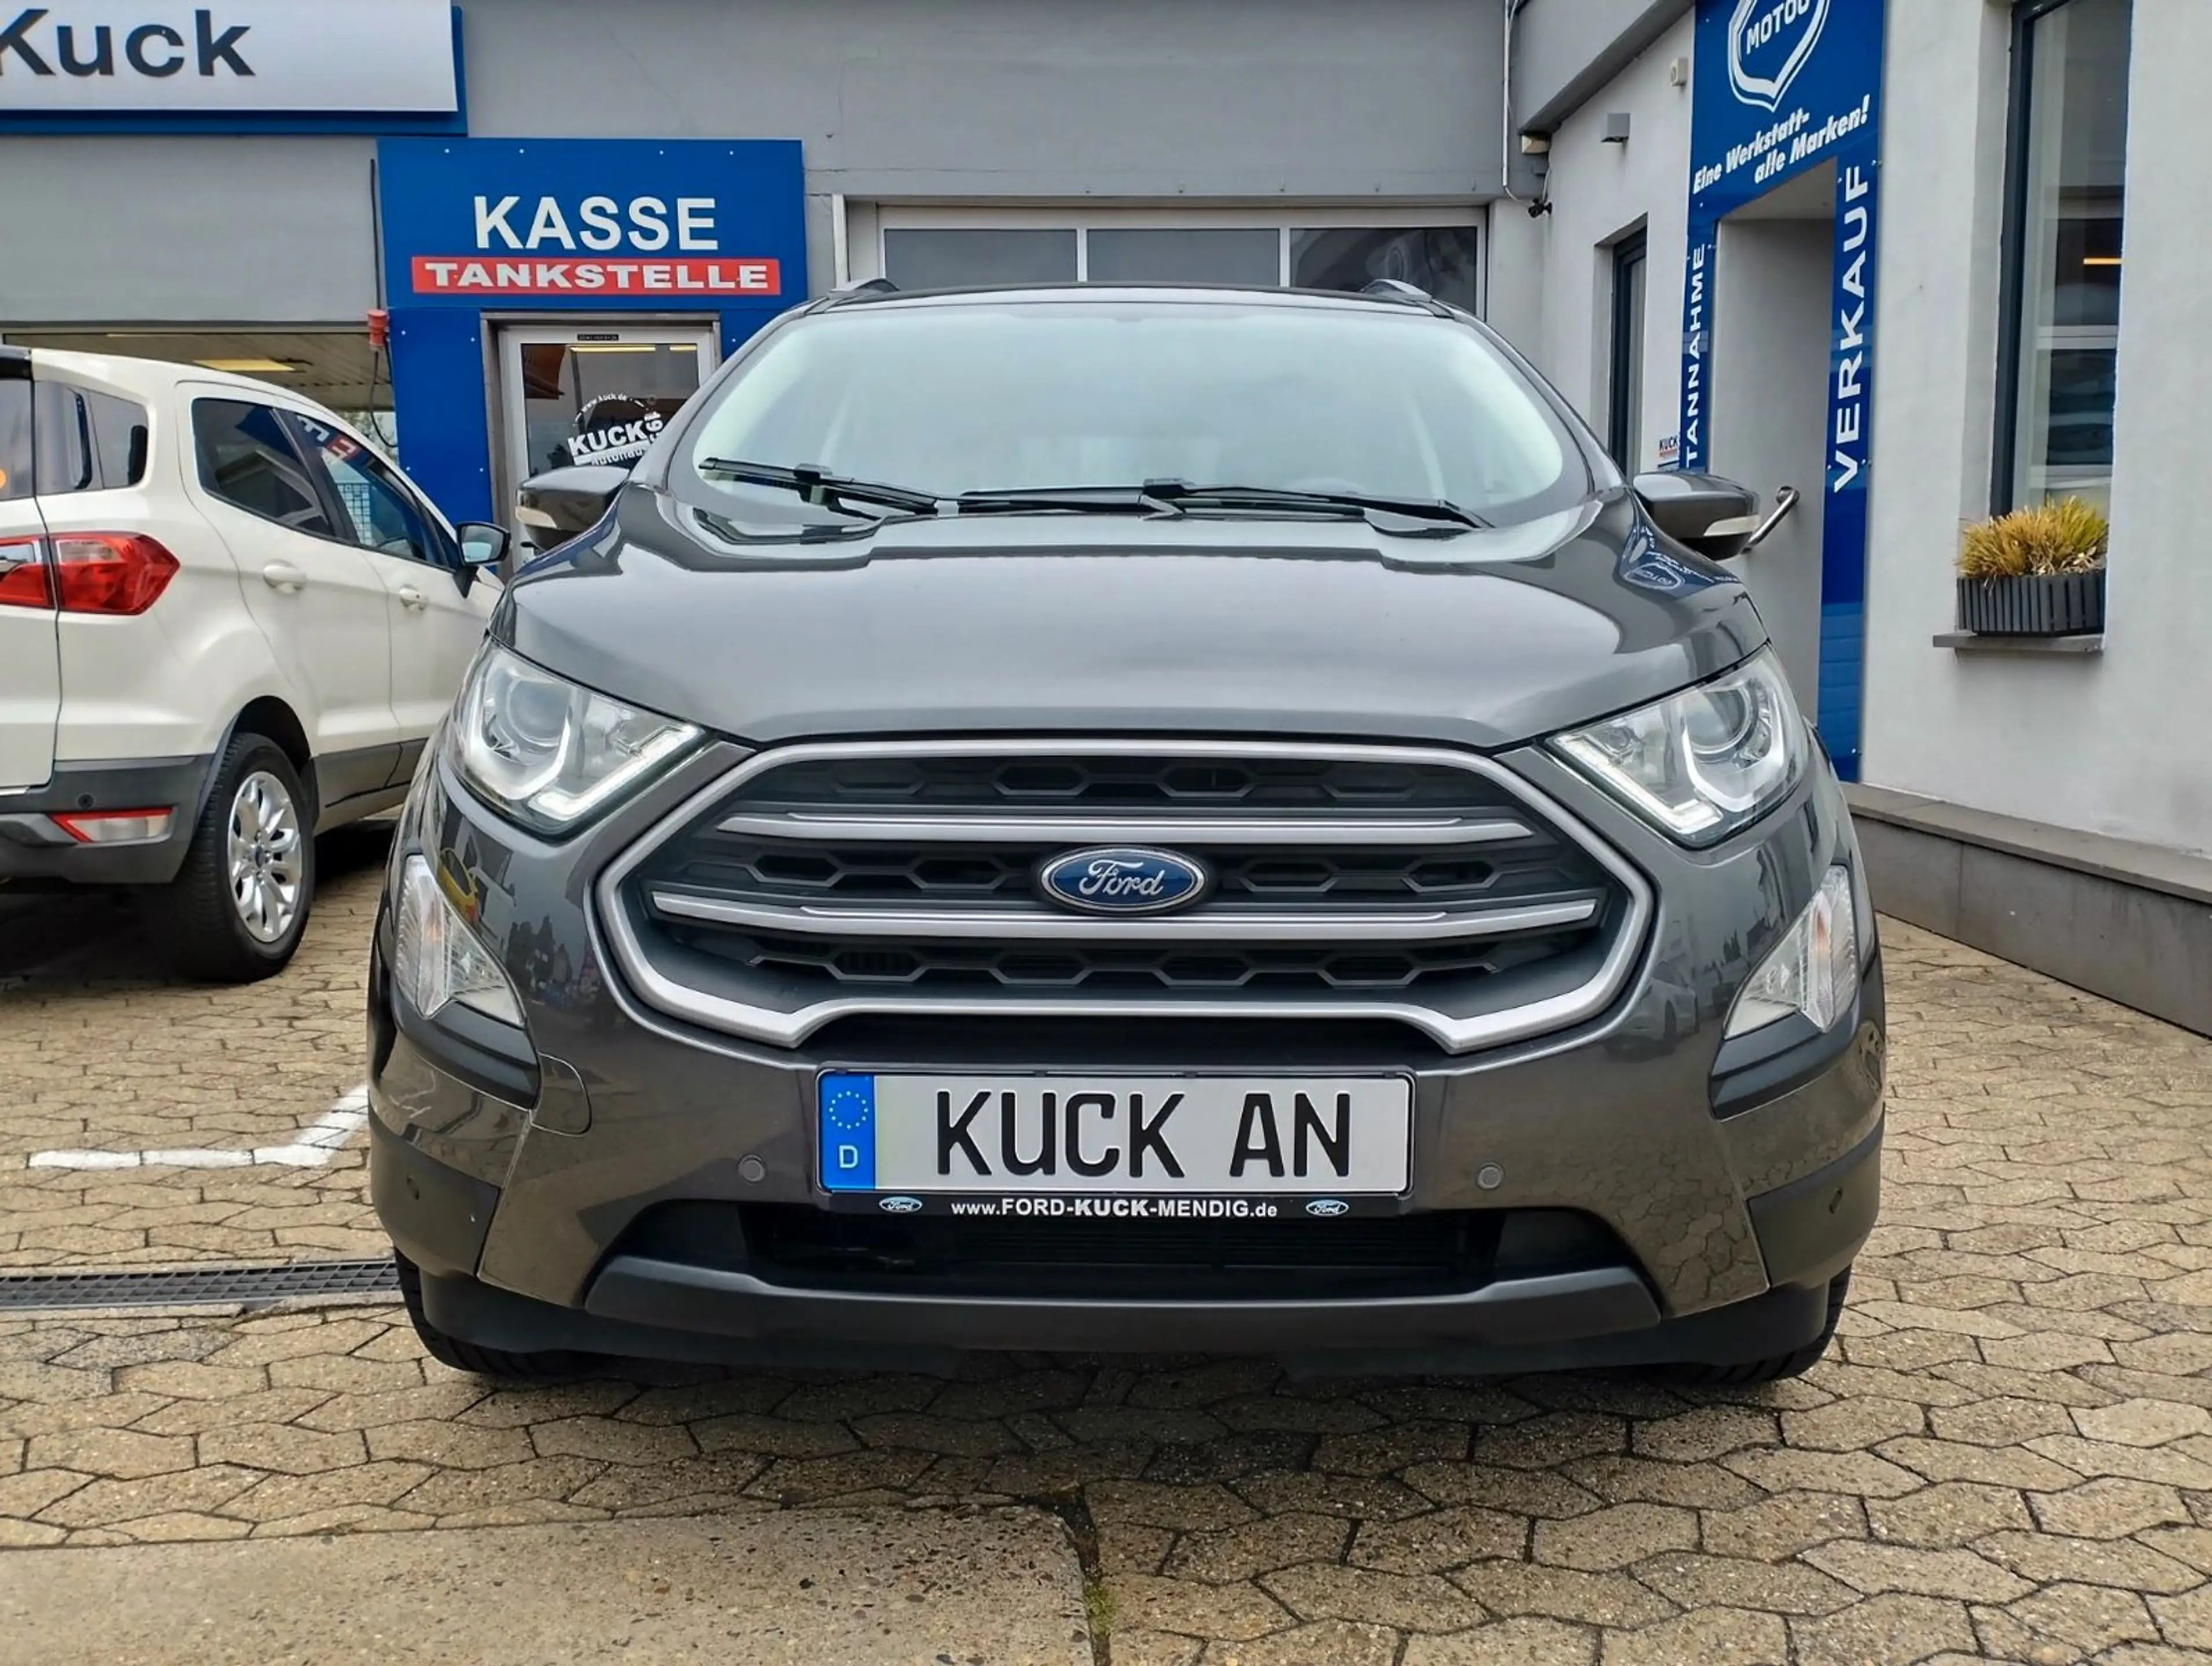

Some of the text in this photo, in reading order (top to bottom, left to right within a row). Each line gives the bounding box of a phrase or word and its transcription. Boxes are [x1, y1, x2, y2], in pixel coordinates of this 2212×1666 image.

[0, 8, 256, 78] Kuck
[1693, 108, 1810, 195] Eine Werkstatt-
[1754, 94, 1870, 185] alle Marken!
[474, 196, 719, 250] KASSE
[424, 262, 768, 289] TANKSTELLE
[1834, 165, 1868, 493] VERKAUF
[567, 420, 647, 456] KUCK
[1078, 859, 1166, 895] Ford
[840, 1145, 859, 1169] D
[936, 1090, 1350, 1178] KUCK AN
[951, 1198, 1278, 1218] www.FORD-KUCK-MENDIG.de
